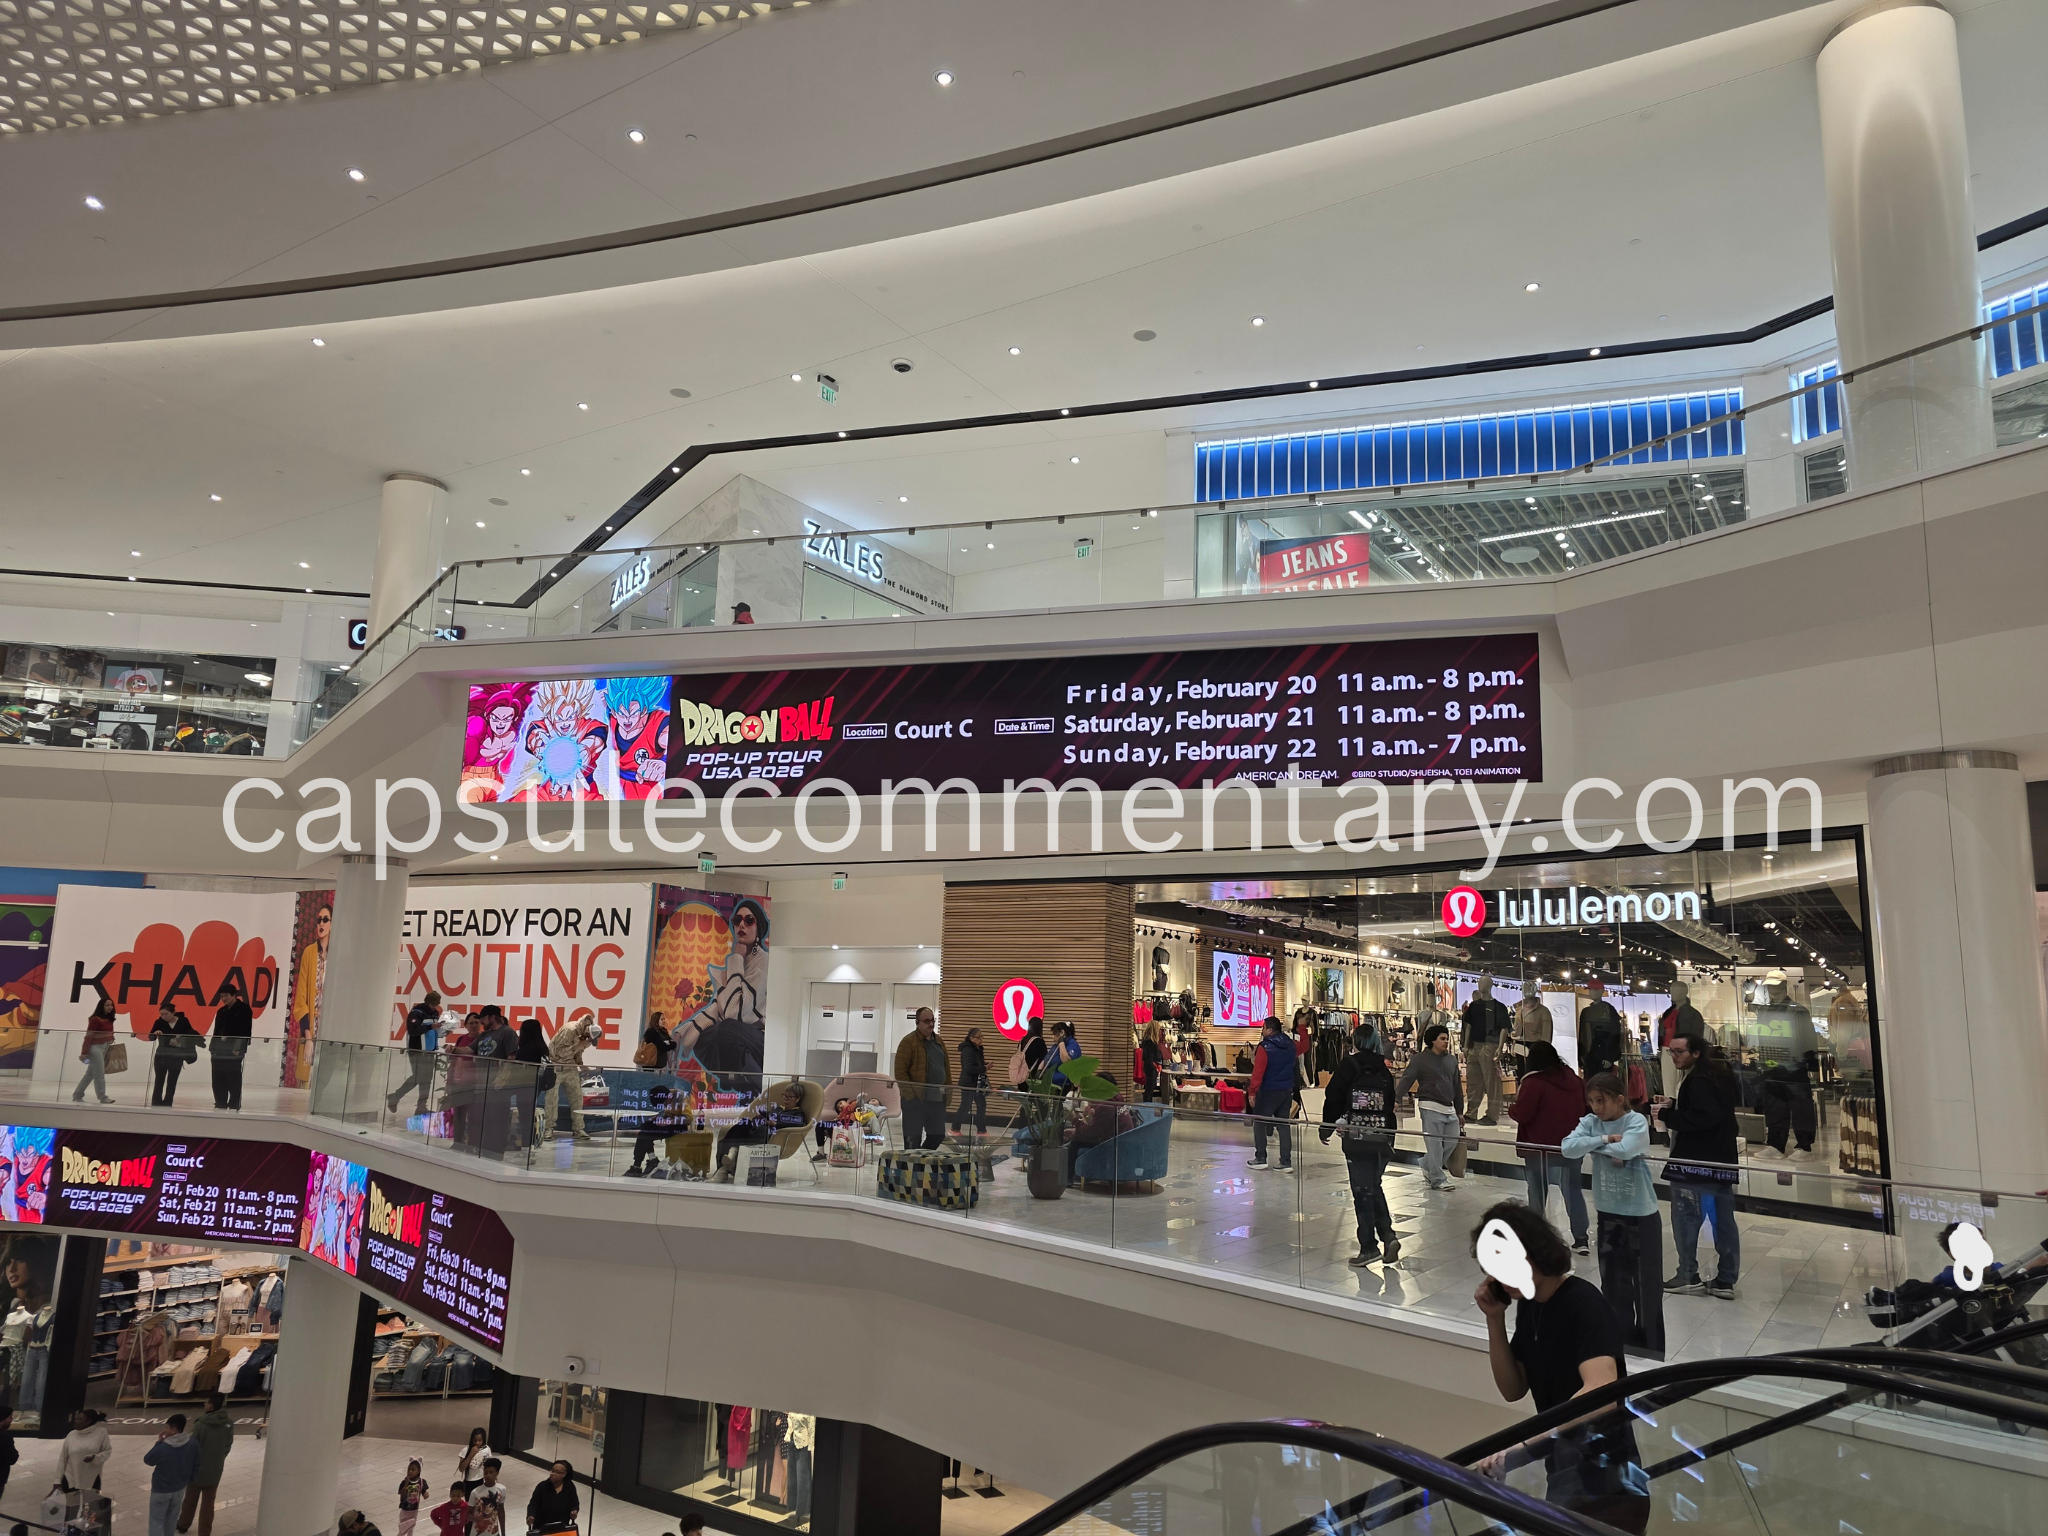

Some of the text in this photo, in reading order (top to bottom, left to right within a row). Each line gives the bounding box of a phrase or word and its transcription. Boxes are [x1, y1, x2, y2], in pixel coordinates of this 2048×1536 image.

[821, 385, 835, 404] EXIT
[1077, 546, 1090, 558] EXIT
[1281, 539, 1349, 578] JEANS
[806, 520, 949, 613] ZALES THE DIAMOND STORE
[609, 557, 647, 607] ZALES
[1066, 683, 1173, 706] Friday,
[1177, 678, 1279, 702] February
[1287, 675, 1317, 695] 20
[1337, 673, 1363, 693] 11
[1443, 668, 1459, 689] 8
[1468, 669, 1524, 692] p.m.
[846, 726, 885, 737] Location
[894, 719, 974, 739] Court C
[1063, 712, 1172, 736] Saturday,
[1176, 709, 1279, 733] February
[1287, 707, 1314, 727] 21
[1337, 704, 1363, 725] 11
[1444, 701, 1461, 721] 8
[1469, 702, 1526, 725] p.m.
[686, 750, 823, 766] POP-UP TOUR
[1063, 742, 1169, 767] Sunday,
[1175, 740, 1279, 764] February
[1287, 738, 1317, 759] 22
[1337, 737, 1364, 757] 11
[1447, 734, 1463, 754] 7
[1470, 735, 1527, 759] p.m.
[701, 765, 805, 779] USA 2026
[1235, 770, 1294, 782] AMERICAN
[1454, 768, 1473, 776] TOEI
[1474, 767, 1521, 776] ANIMATION
[1498, 886, 1701, 927] lululemon
[402, 907, 631, 937] ET READY FOR AN
[69, 959, 280, 1009] KHAADI
[395, 942, 626, 1000] XCITING
[165, 1154, 205, 1168] Court C
[61, 1188, 146, 1205] POP-UP TOUR
[161, 1182, 299, 1205] Fri, Feb 20 11 a.m. 8 p.m.
[69, 1200, 134, 1215] USA 2026
[159, 1196, 181, 1210] Sat,
[183, 1198, 203, 1211] Feb
[203, 1200, 217, 1212] 21
[223, 1202, 235, 1214] 11
[236, 1205, 258, 1216] a.m.
[265, 1205, 272, 1217] 8
[273, 1207, 296, 1220] p.m.
[430, 1207, 454, 1229] Court C
[157, 1210, 180, 1225] Sun,
[181, 1212, 201, 1225] Feb
[201, 1214, 215, 1227] 22
[221, 1216, 233, 1228] 11
[234, 1219, 256, 1231] a.m.
[264, 1219, 272, 1231] 7
[272, 1221, 295, 1235] p.m.
[367, 1238, 416, 1271] POP-UP TOUR
[426, 1243, 439, 1262] Fri,
[440, 1247, 451, 1267] Feb
[451, 1253, 460, 1269] 20
[462, 1258, 470, 1273] 11
[486, 1267, 493, 1284] 8
[492, 1274, 508, 1290] p.m.
[370, 1254, 408, 1283] USA 2026
[424, 1260, 437, 1280] Sat,
[438, 1266, 449, 1285] Feb
[449, 1272, 458, 1288] 21
[460, 1276, 468, 1292] 11
[484, 1287, 490, 1303] 8
[489, 1294, 505, 1310] p.m.
[422, 1279, 436, 1299] Sun,
[435, 1284, 447, 1303] Feb
[447, 1290, 456, 1307] 22
[458, 1295, 466, 1312] 11
[482, 1307, 489, 1323] 7
[487, 1313, 503, 1331] p.m.
